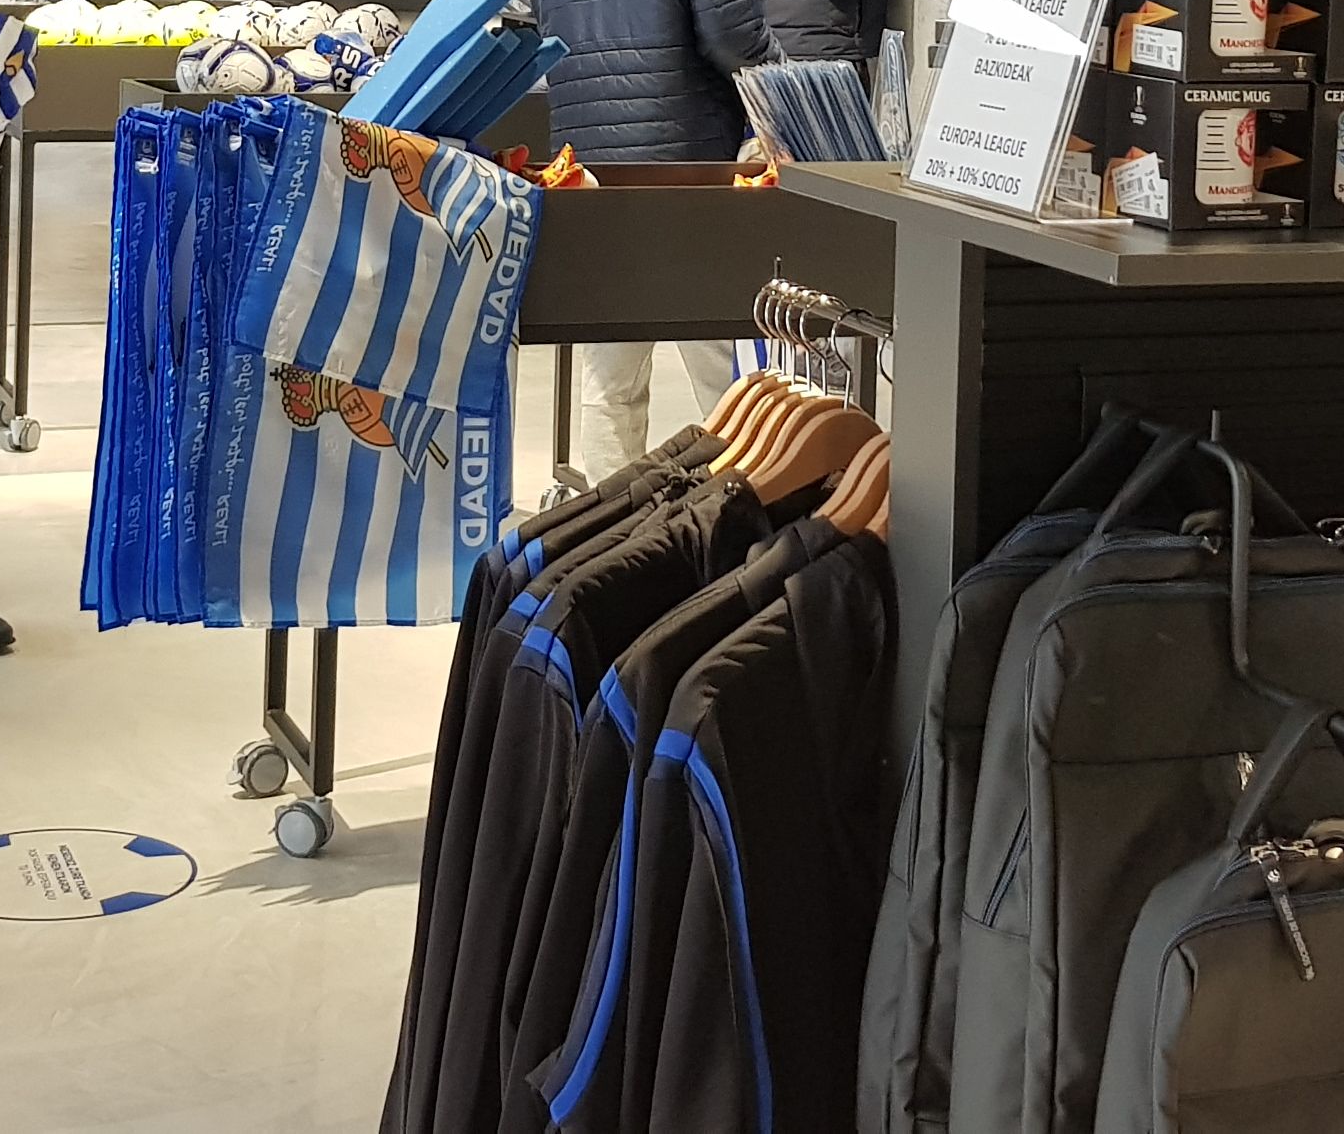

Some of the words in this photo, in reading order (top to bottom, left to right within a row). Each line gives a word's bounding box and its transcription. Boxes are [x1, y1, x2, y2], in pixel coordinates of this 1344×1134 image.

[974, 57, 1034, 83] BAZKIDEAK
[1184, 89, 1240, 103] CERAMIC
[1242, 91, 1271, 104] MUG
[939, 124, 982, 149] EUROPA
[983, 133, 1028, 158] LEAGUE
[925, 158, 948, 179] 20%
[956, 165, 980, 186] 10%
[981, 171, 1022, 195] SOCIOS
